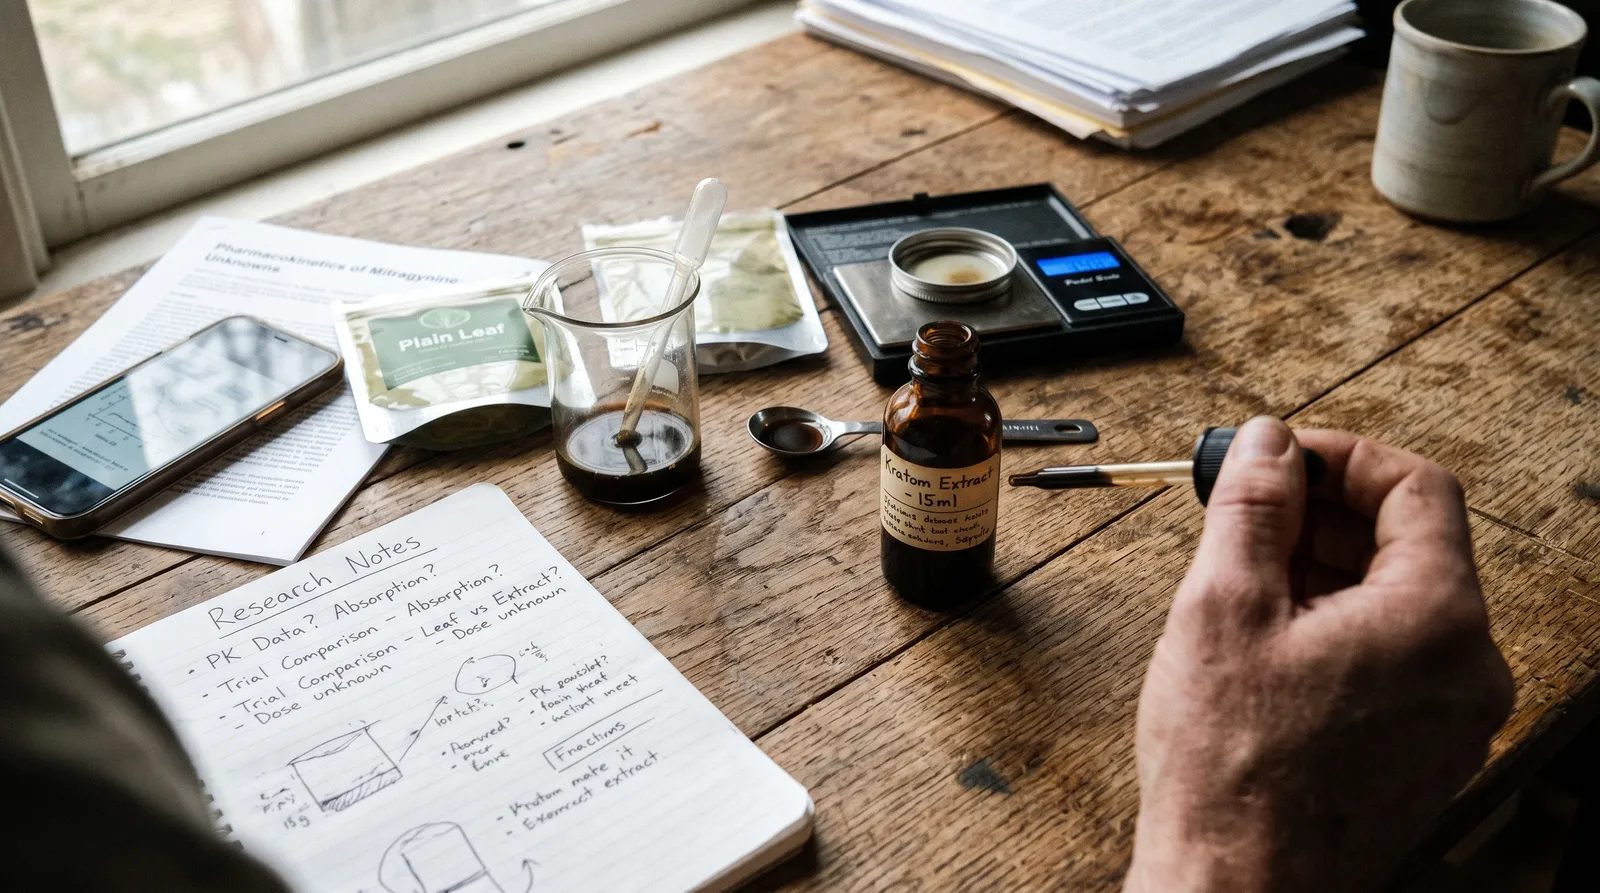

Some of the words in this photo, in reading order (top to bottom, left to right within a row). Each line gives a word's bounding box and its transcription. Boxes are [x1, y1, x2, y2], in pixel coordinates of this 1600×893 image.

[350, 265, 368, 274] of
[399, 333, 454, 352] Plain
[458, 323, 505, 341] Leaf
[885, 453, 931, 488] Kratom
[939, 465, 994, 491] Extract
[918, 492, 957, 508] 15ml
[207, 571, 332, 630] Research
[345, 536, 421, 574] Notes
[206, 647, 242, 670] PK
[252, 613, 318, 651] Data?
[334, 563, 437, 620] Absorption?
[217, 666, 269, 694] Trial
[281, 625, 378, 670] Comparison
[407, 563, 503, 616] Absorption?
[452, 620, 491, 640] Dose
[498, 587, 566, 621] unknown
[233, 686, 286, 714] Trial
[298, 643, 397, 690] Comparison
[421, 612, 459, 638] Leaf
[470, 604, 488, 617] vs
[492, 566, 562, 605] Extract?
[254, 701, 302, 725] Dose
[313, 662, 392, 701] unknown
[530, 684, 551, 699] PK
[604, 750, 659, 788] extract
